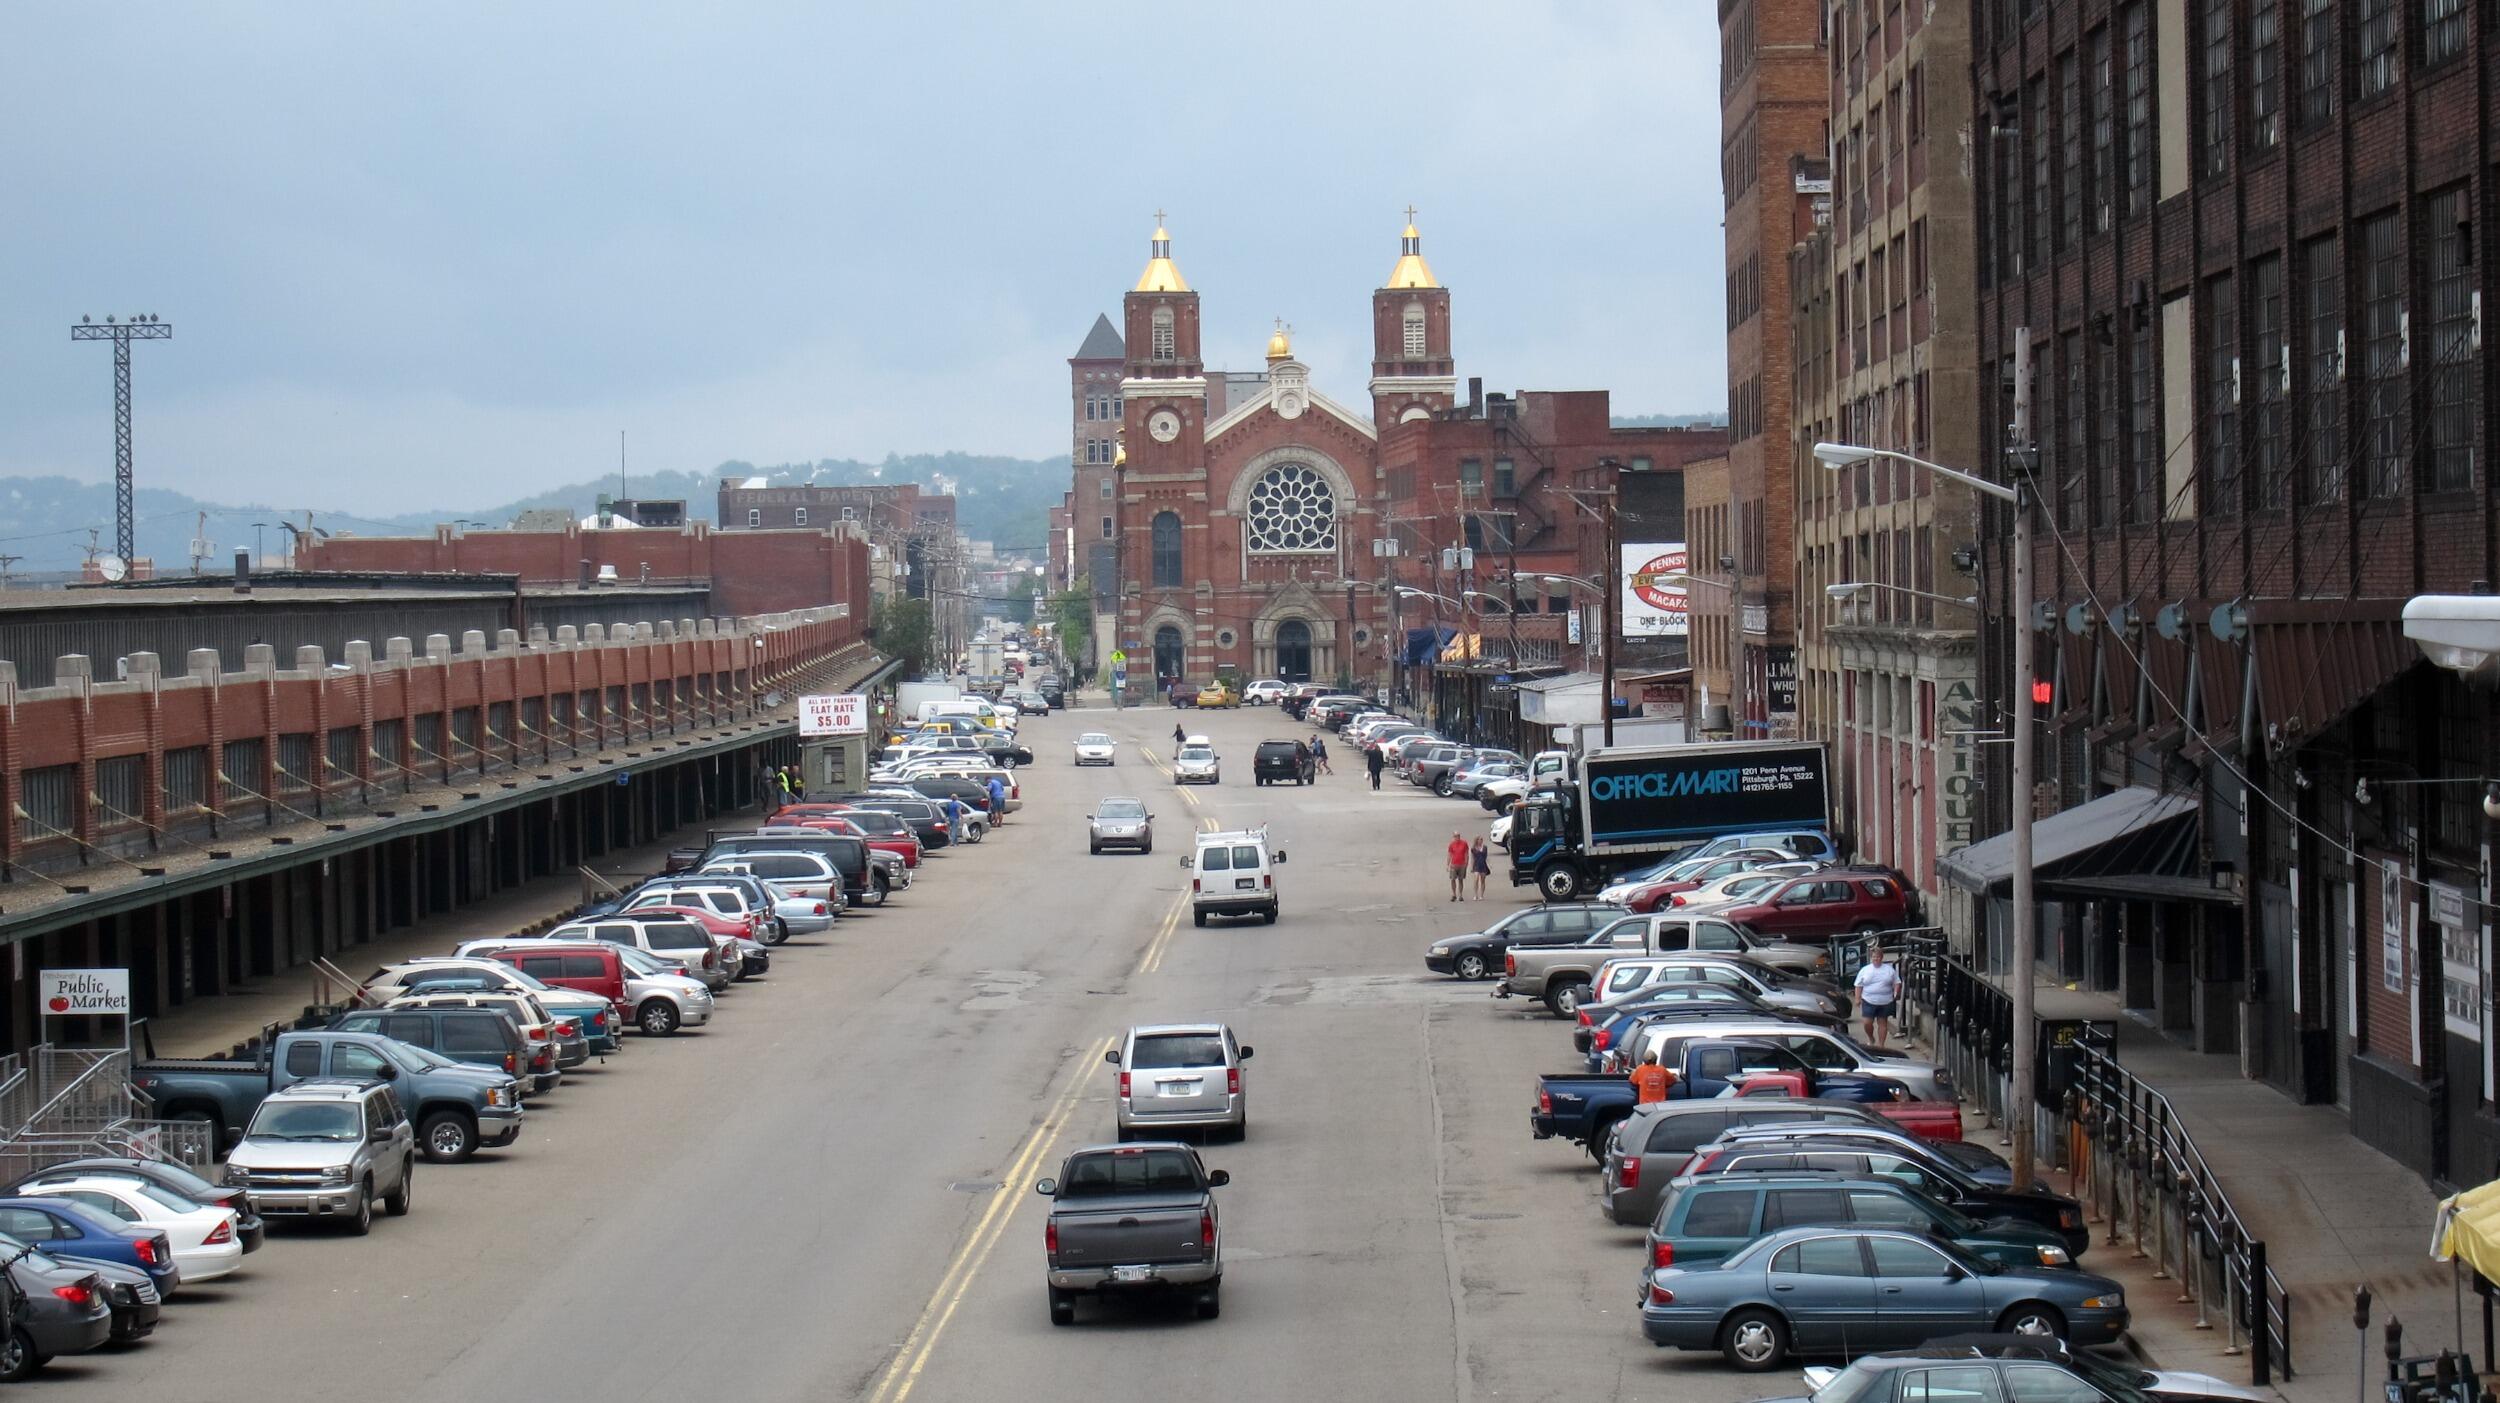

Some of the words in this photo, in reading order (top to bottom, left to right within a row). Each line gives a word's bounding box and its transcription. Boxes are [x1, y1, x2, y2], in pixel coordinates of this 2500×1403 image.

[737, 490, 808, 503] FEDERAL
[819, 488, 875, 503] PAPER
[1640, 616, 1656, 626] ONE
[1660, 616, 1687, 626] BLOCK
[810, 704, 831, 714] FLAT
[834, 704, 855, 713] RATE
[817, 715, 850, 727] $5.00
[1742, 767, 1758, 775] 1201
[1760, 766, 1778, 774] Penn
[1780, 765, 1806, 773] Avenue
[1780, 773, 1791, 782] Pa.
[1793, 771, 1814, 781] 15222
[57, 974, 104, 993] Public
[71, 989, 127, 1009] Market
